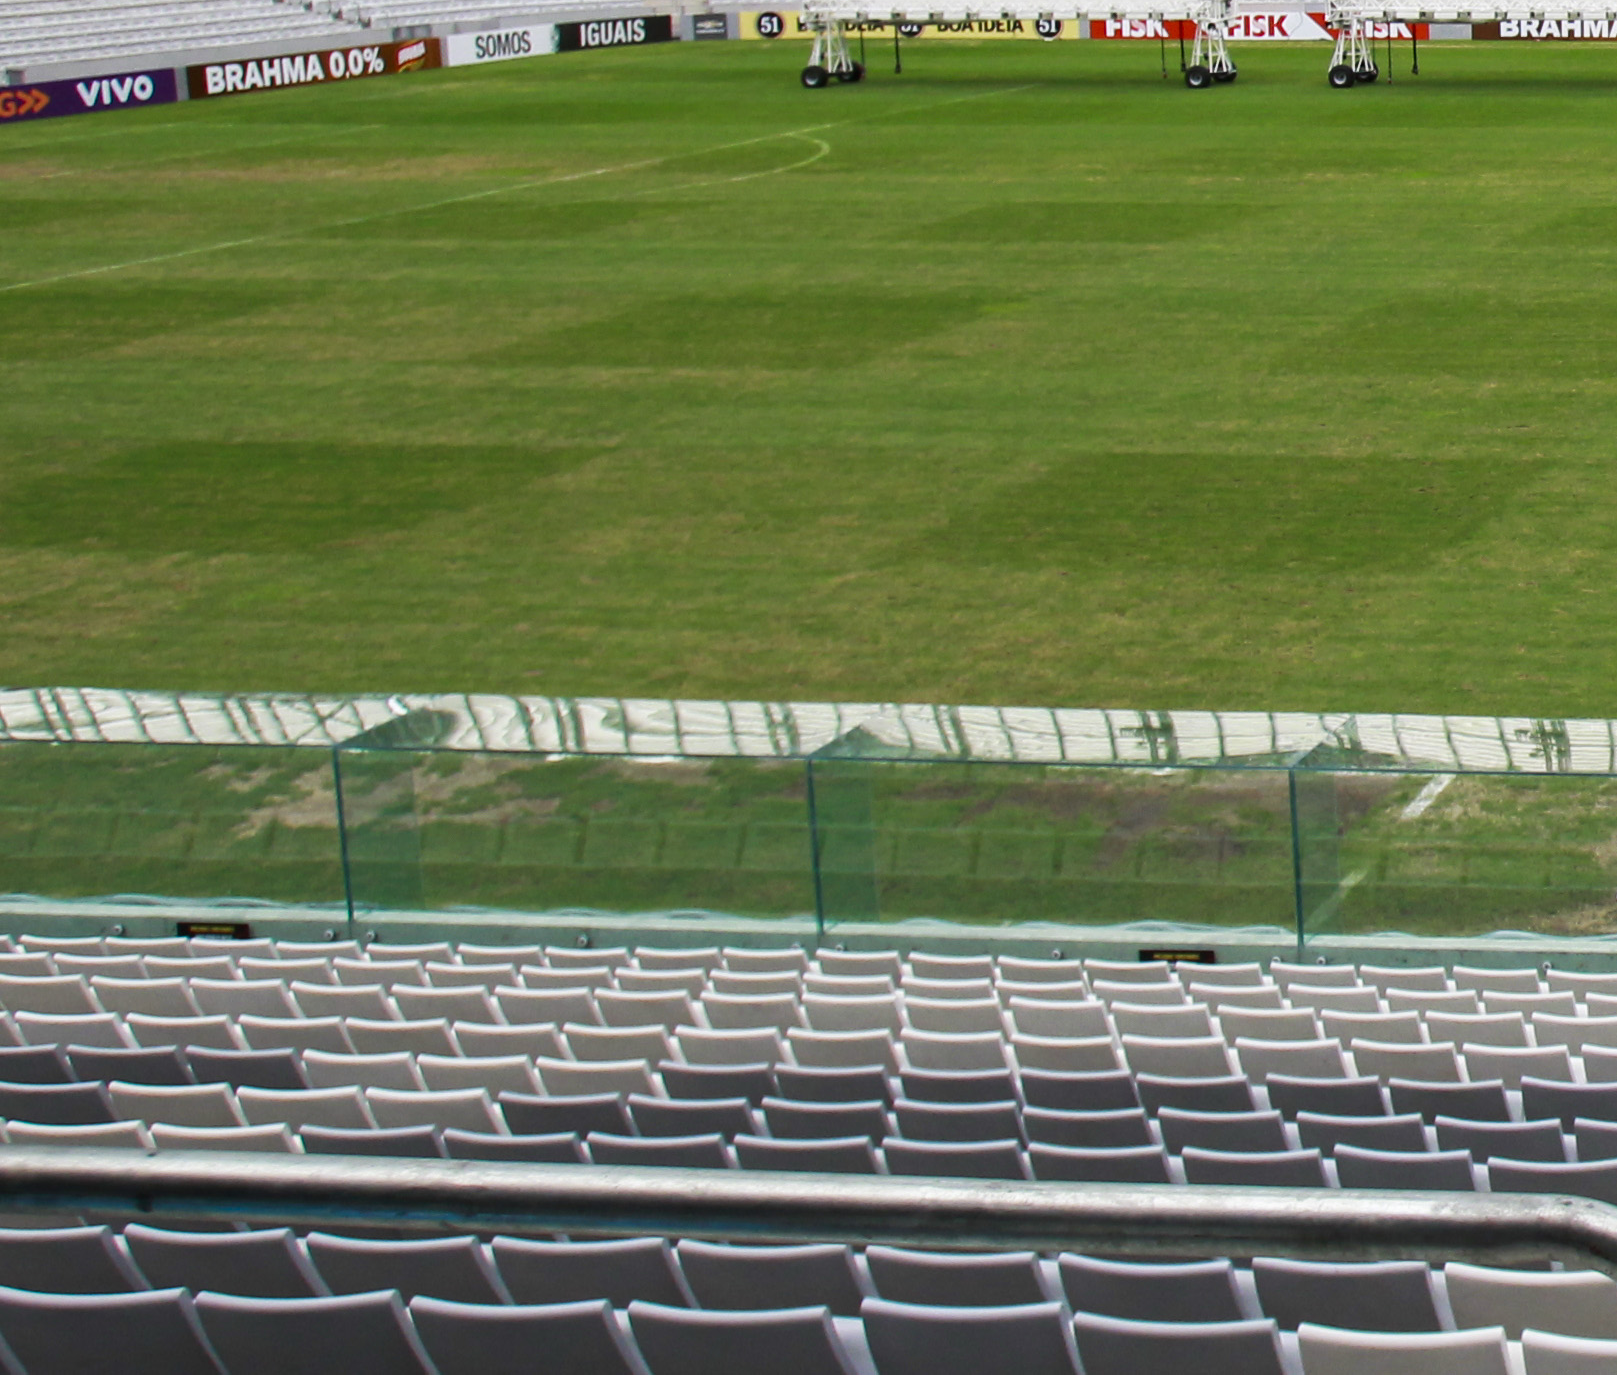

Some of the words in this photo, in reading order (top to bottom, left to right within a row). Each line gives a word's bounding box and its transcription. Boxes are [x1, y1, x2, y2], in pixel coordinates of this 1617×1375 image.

[580, 19, 645, 47] IGUAIS
[760, 18, 780, 34] 51
[1039, 20, 1058, 34] 51
[1105, 19, 1170, 38] FISK
[1227, 14, 1290, 38] FISK
[1364, 20, 1413, 38] ISK
[475, 31, 532, 60] SOMOS
[205, 54, 325, 95] BRAHMA
